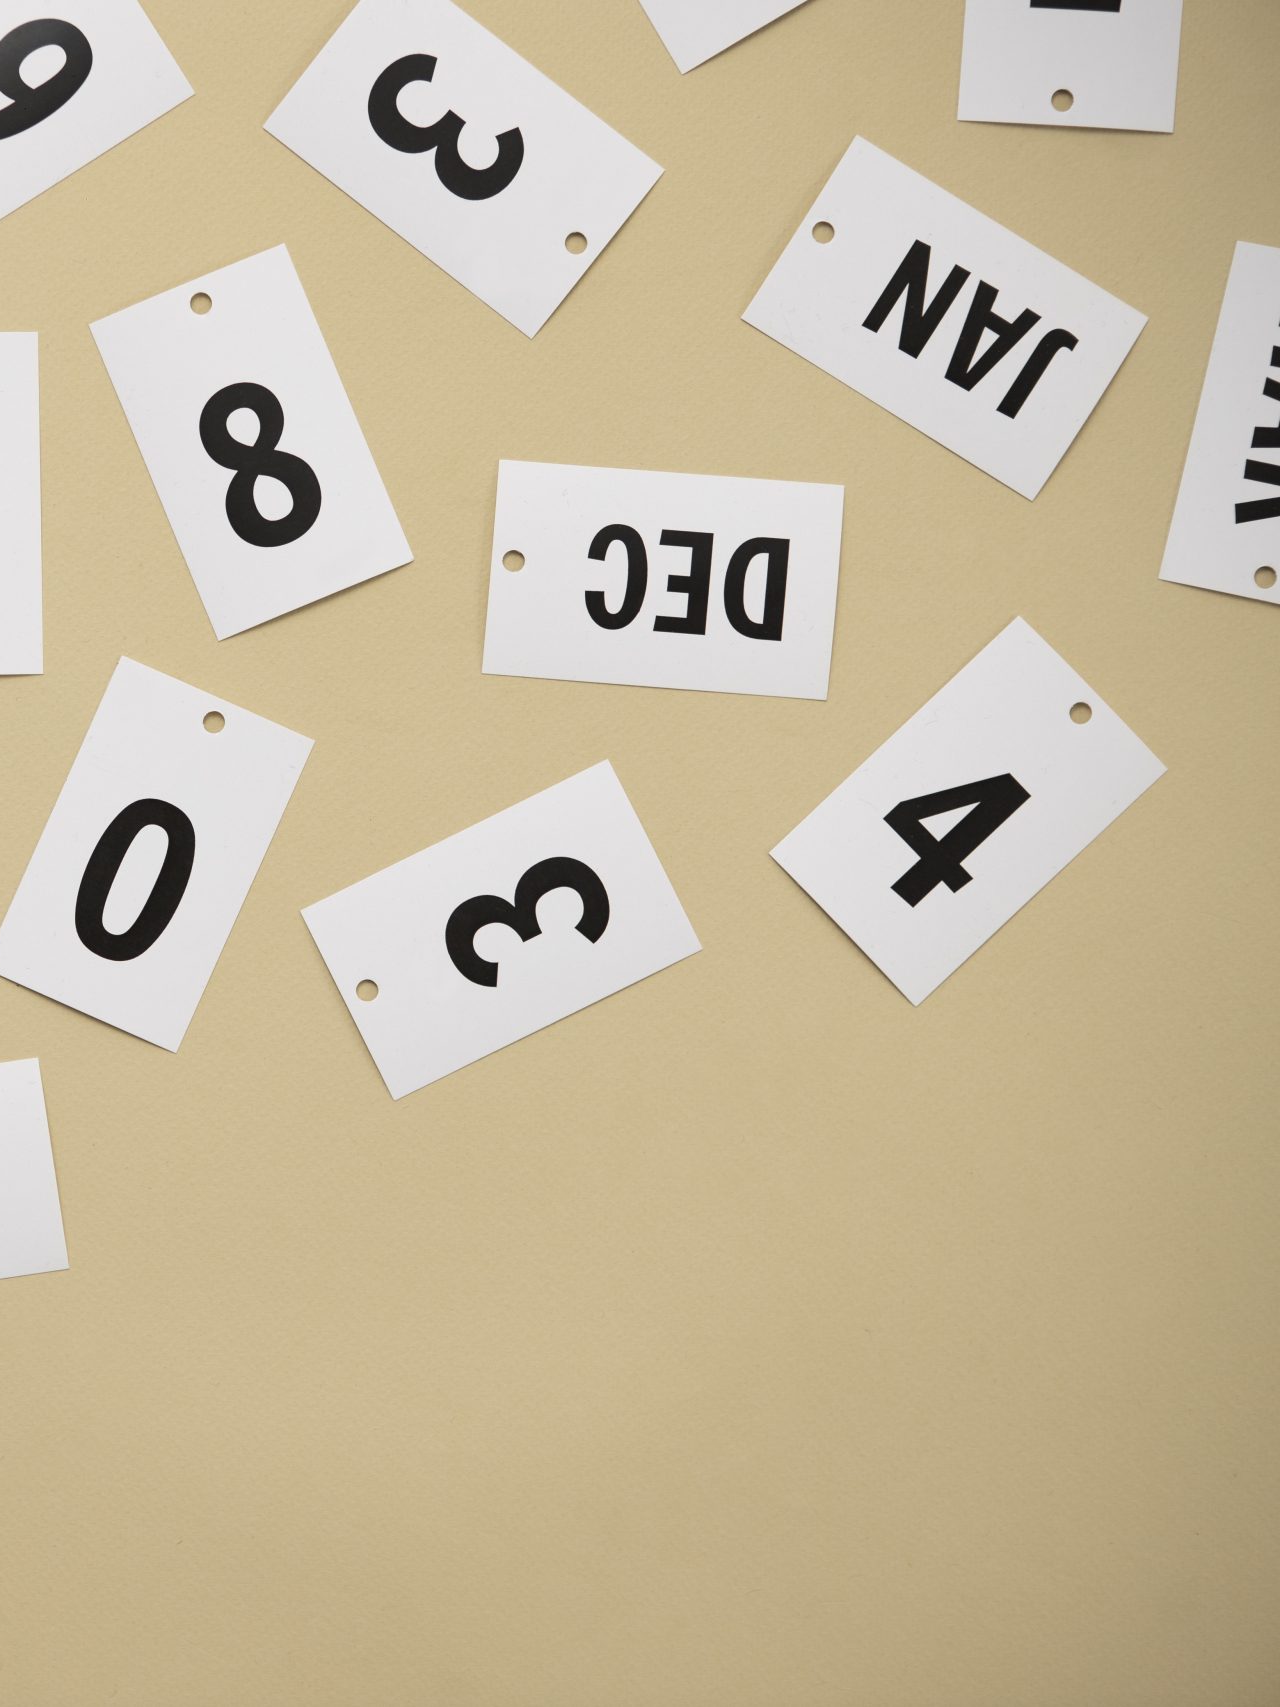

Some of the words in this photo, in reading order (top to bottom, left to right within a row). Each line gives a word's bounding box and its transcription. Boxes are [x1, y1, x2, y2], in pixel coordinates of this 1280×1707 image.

[367, 53, 525, 201] 3
[862, 239, 1079, 420] JAN
[199, 382, 322, 548] 8
[584, 523, 790, 642] DEC
[74, 798, 196, 962] 0
[883, 773, 1031, 908] 4
[445, 856, 610, 988] 3
